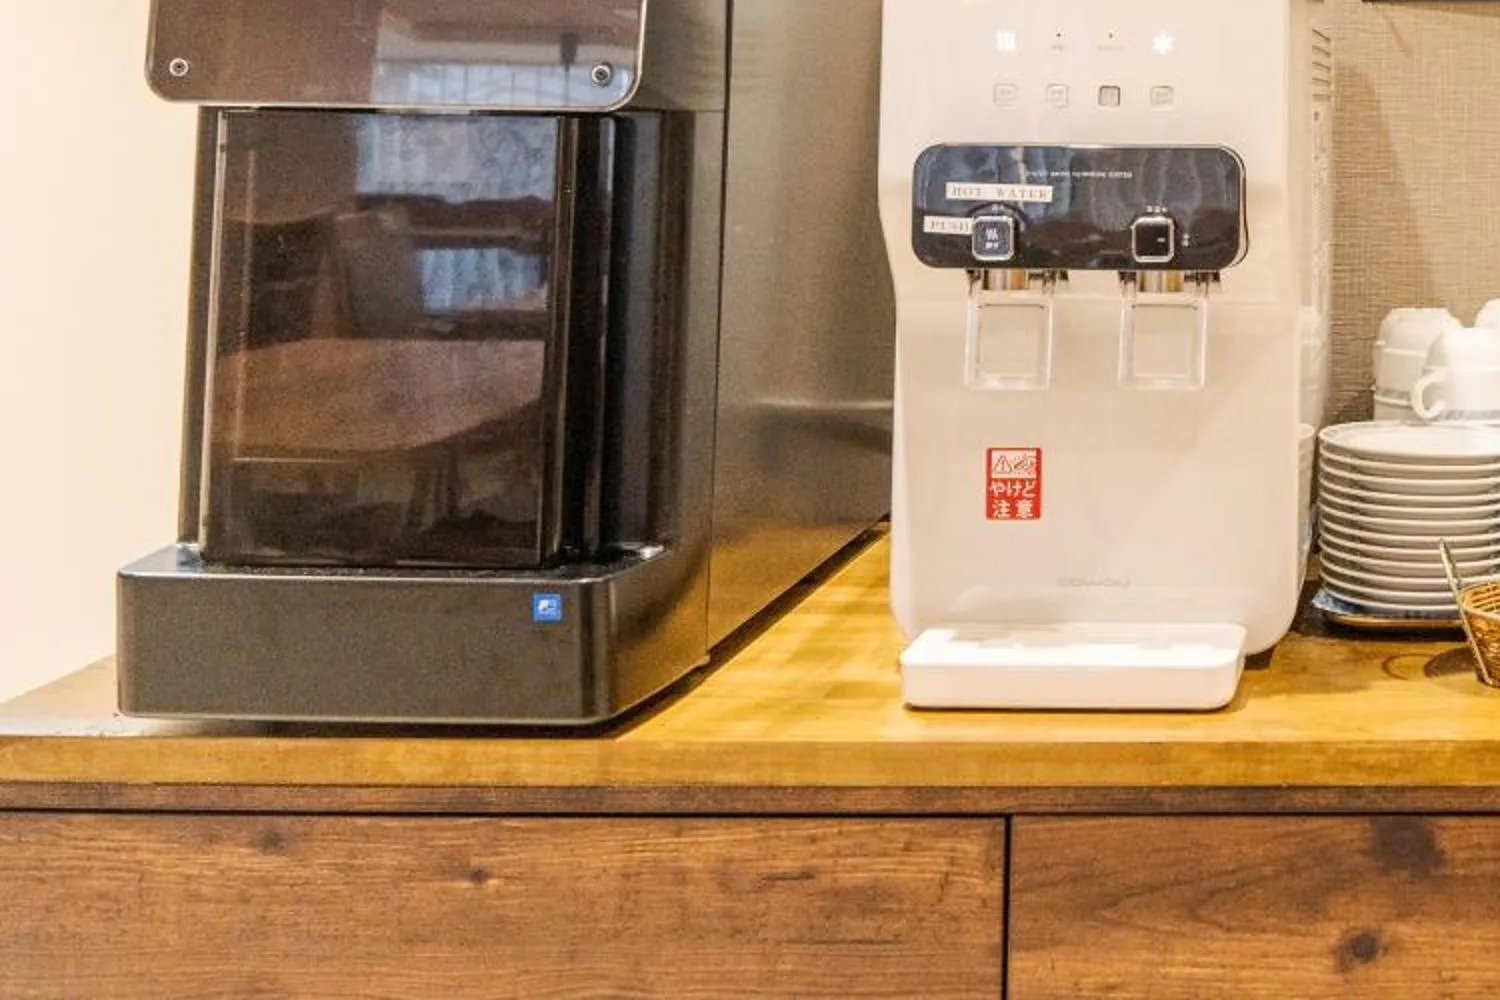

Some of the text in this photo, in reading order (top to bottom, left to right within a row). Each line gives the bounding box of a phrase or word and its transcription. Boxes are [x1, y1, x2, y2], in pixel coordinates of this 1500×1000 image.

[952, 186, 1048, 199] HOT WATER
[990, 480, 1037, 499] やけど
[992, 499, 1035, 520] 注意
